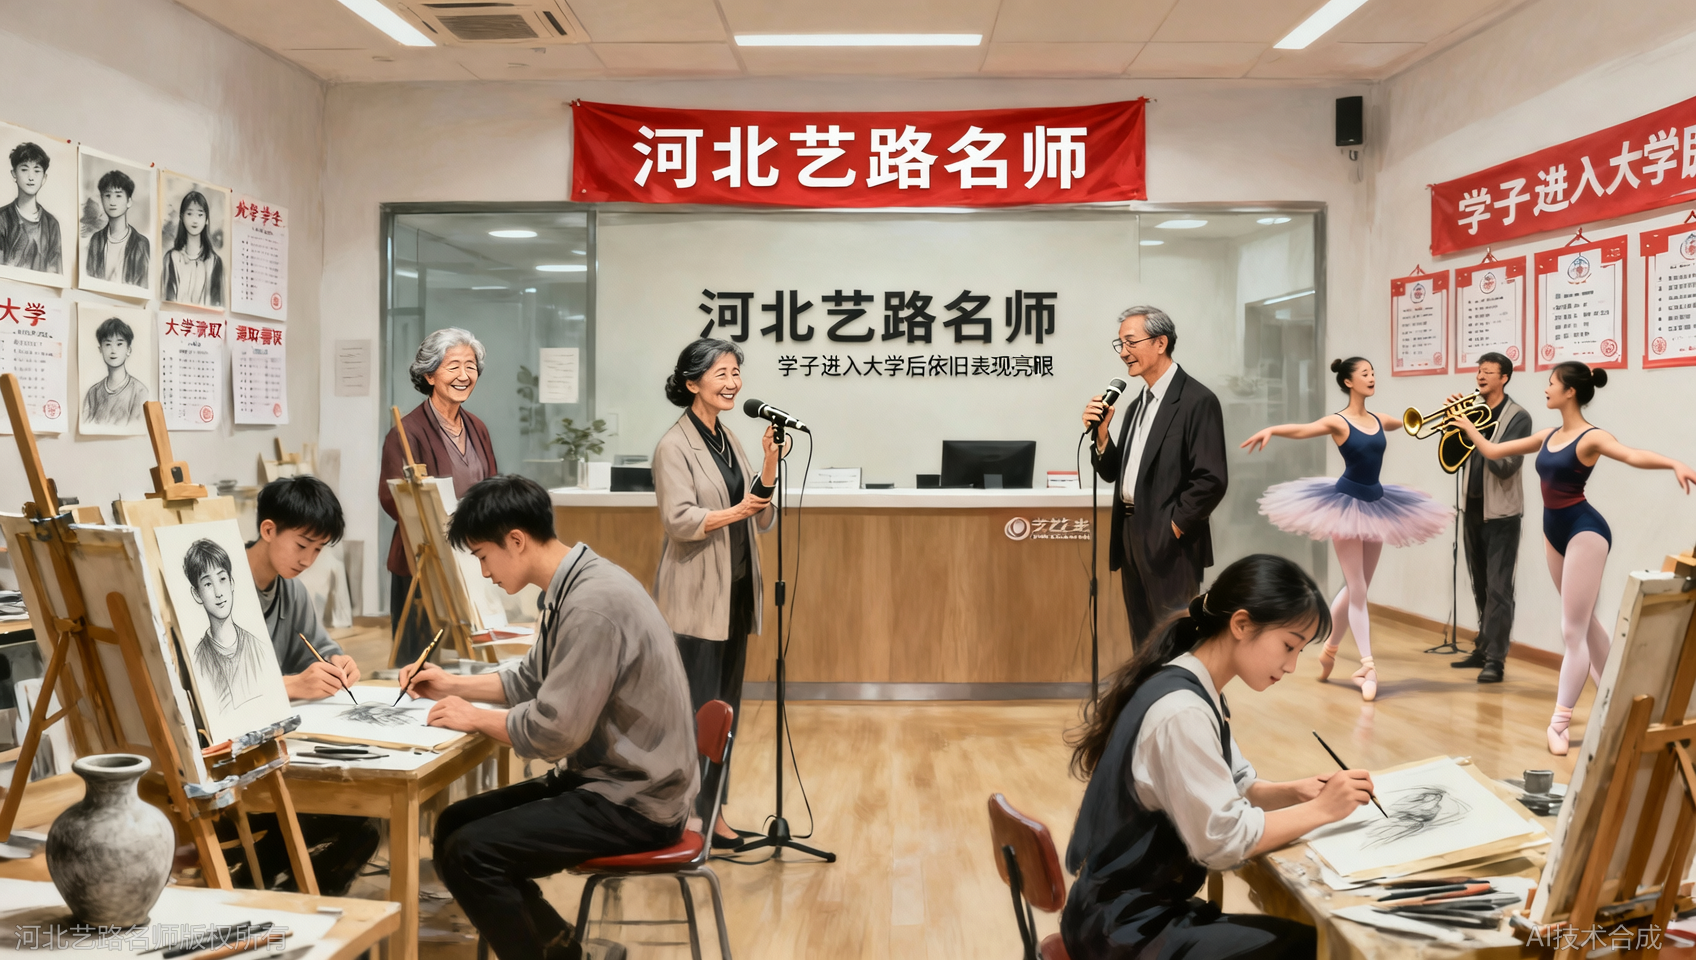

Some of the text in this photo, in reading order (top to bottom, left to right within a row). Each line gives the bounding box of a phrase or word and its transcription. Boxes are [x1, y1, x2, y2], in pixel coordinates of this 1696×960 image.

[632, 124, 1088, 190] 河北艺路名师
[0, 297, 47, 327] 大学
[698, 288, 1058, 344] 河北艺路名师
[778, 354, 1054, 378] 学子进入大学后依旧表现亮眼
